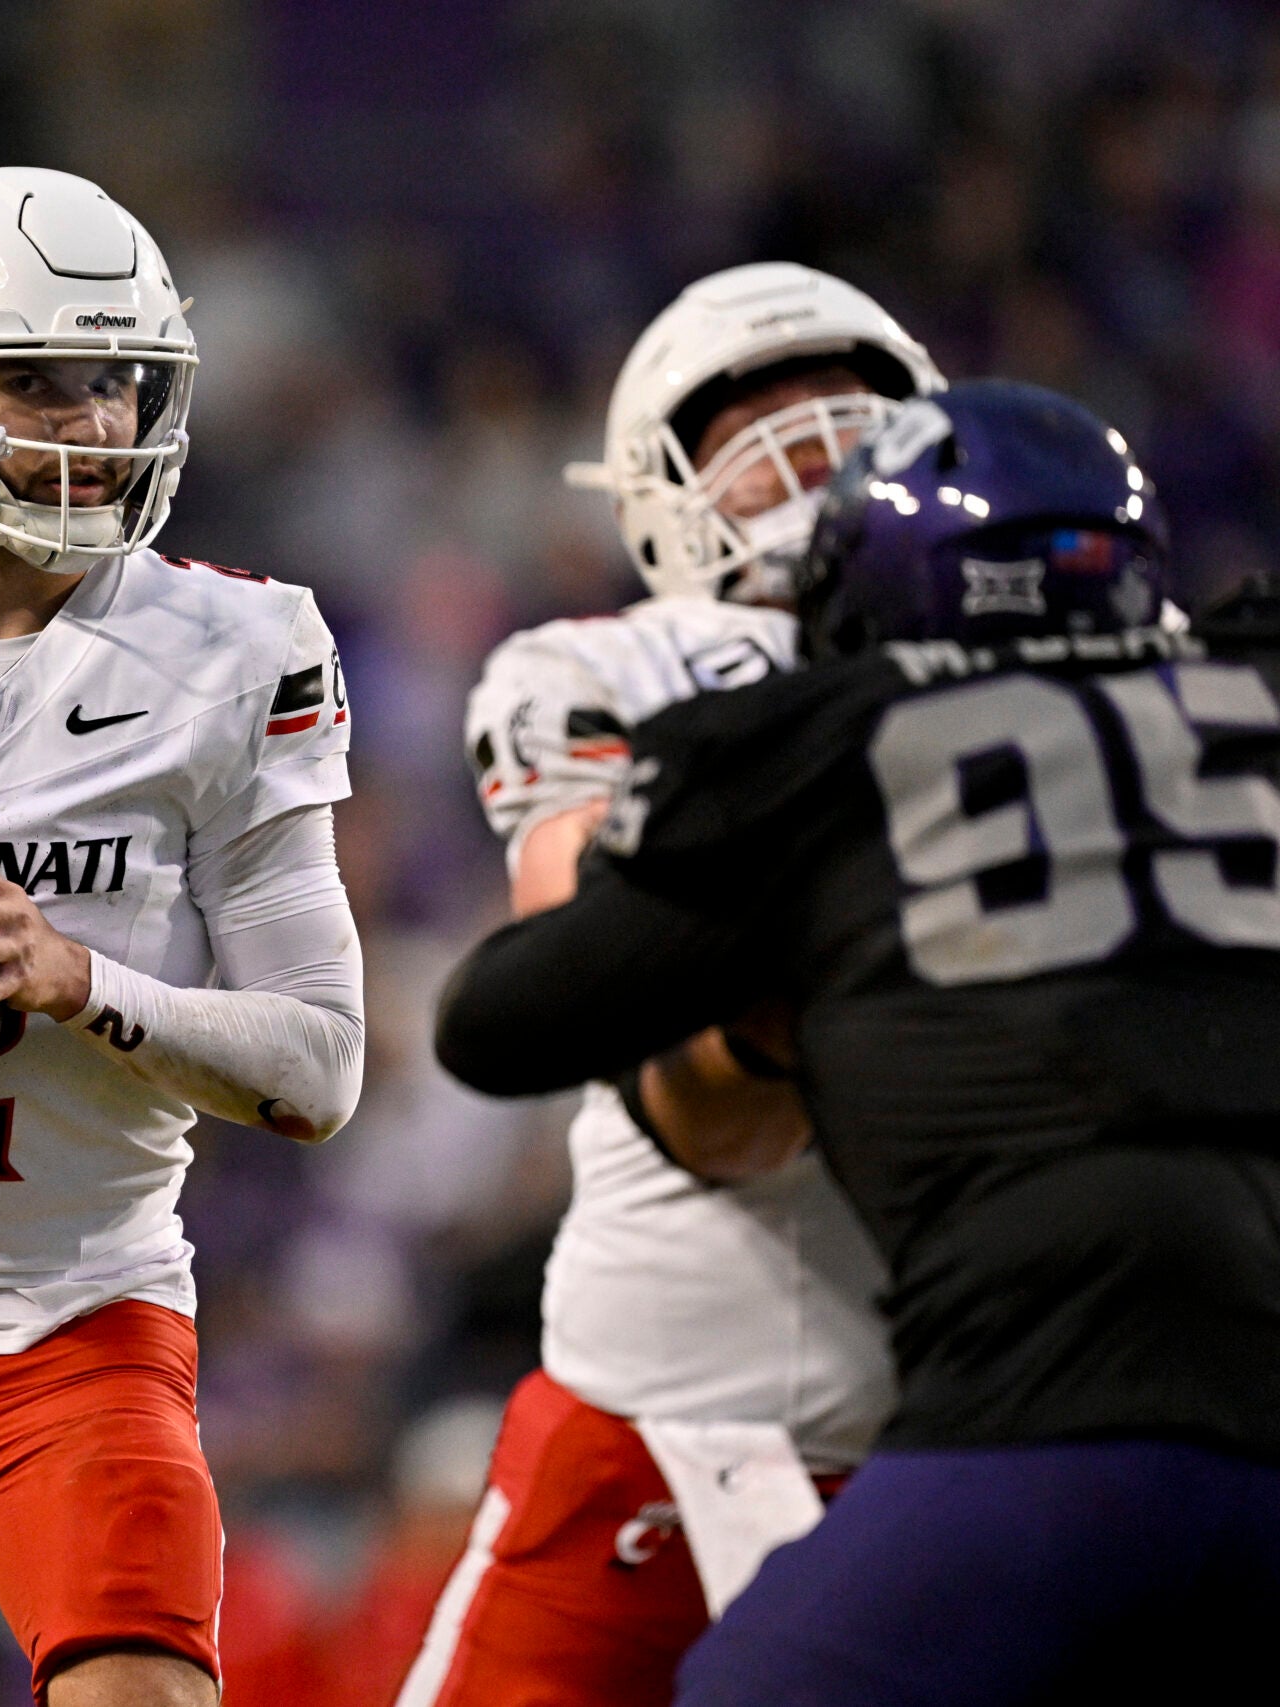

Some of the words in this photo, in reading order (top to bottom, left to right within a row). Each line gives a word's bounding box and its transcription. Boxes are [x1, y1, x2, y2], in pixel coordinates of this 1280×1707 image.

[75, 311, 137, 330] CINCINNATI
[866, 661, 1280, 988] 95
[82, 1003, 145, 1053] 2
